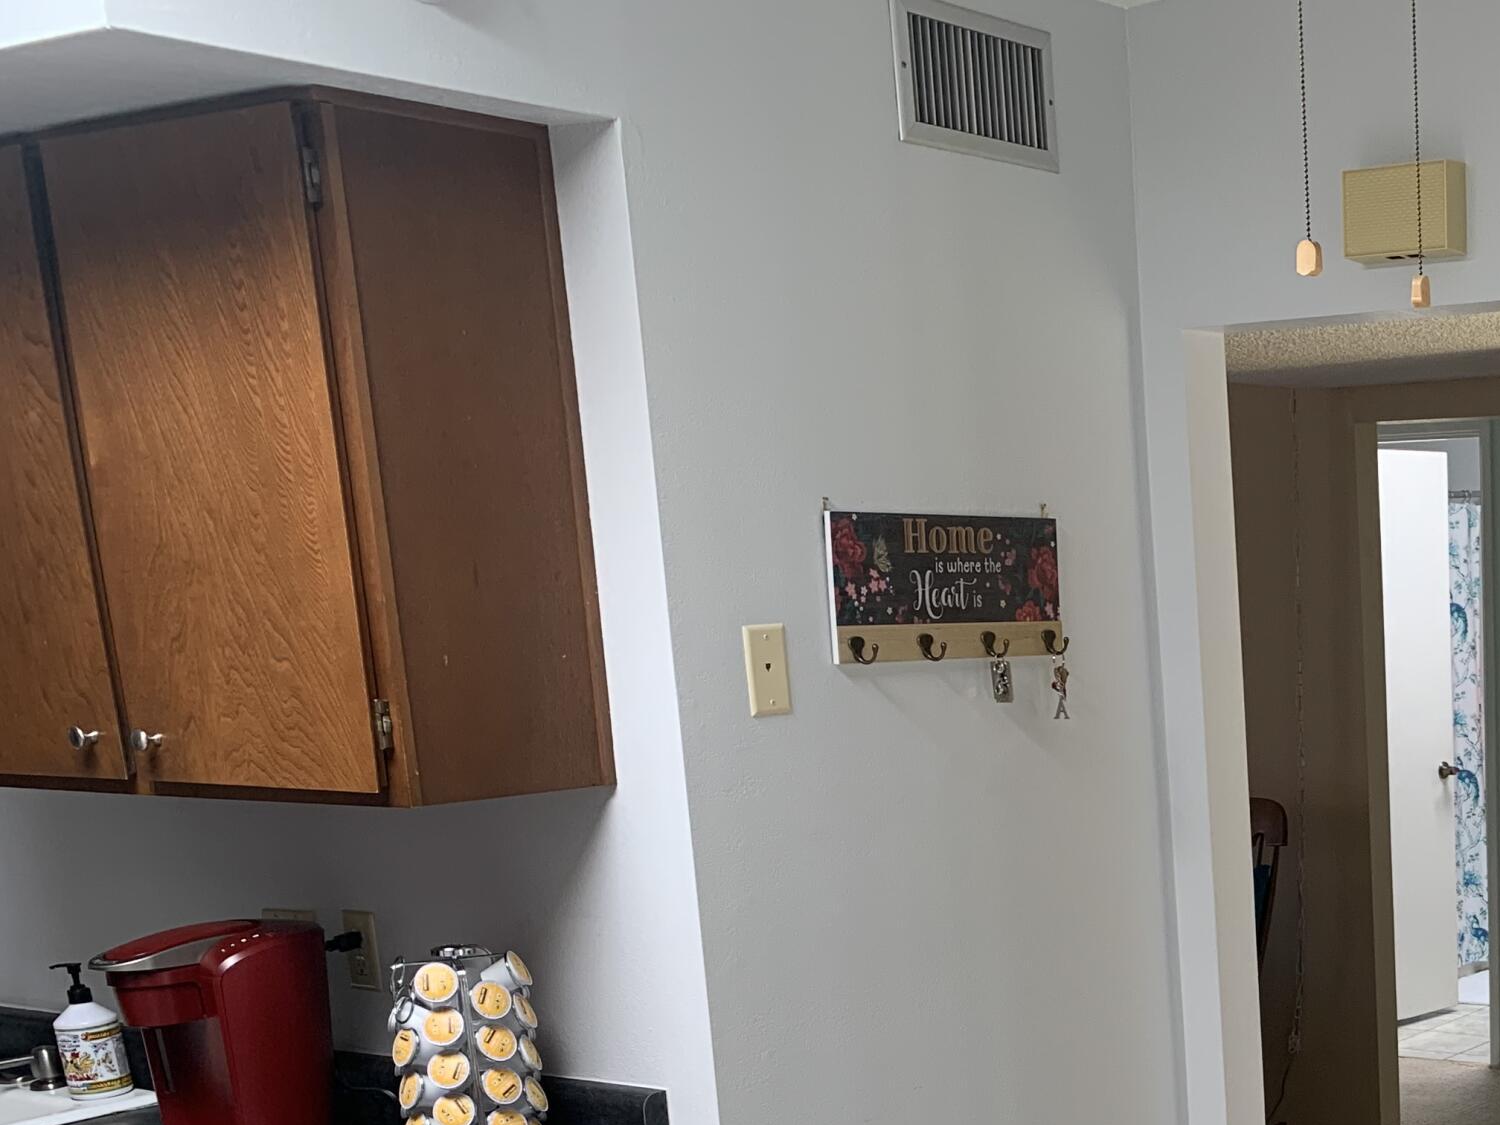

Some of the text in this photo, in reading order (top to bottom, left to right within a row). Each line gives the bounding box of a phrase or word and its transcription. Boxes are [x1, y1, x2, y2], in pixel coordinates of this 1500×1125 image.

[903, 517, 994, 554] Home
[935, 557, 1002, 573] is where the
[909, 569, 983, 620] Heart is
